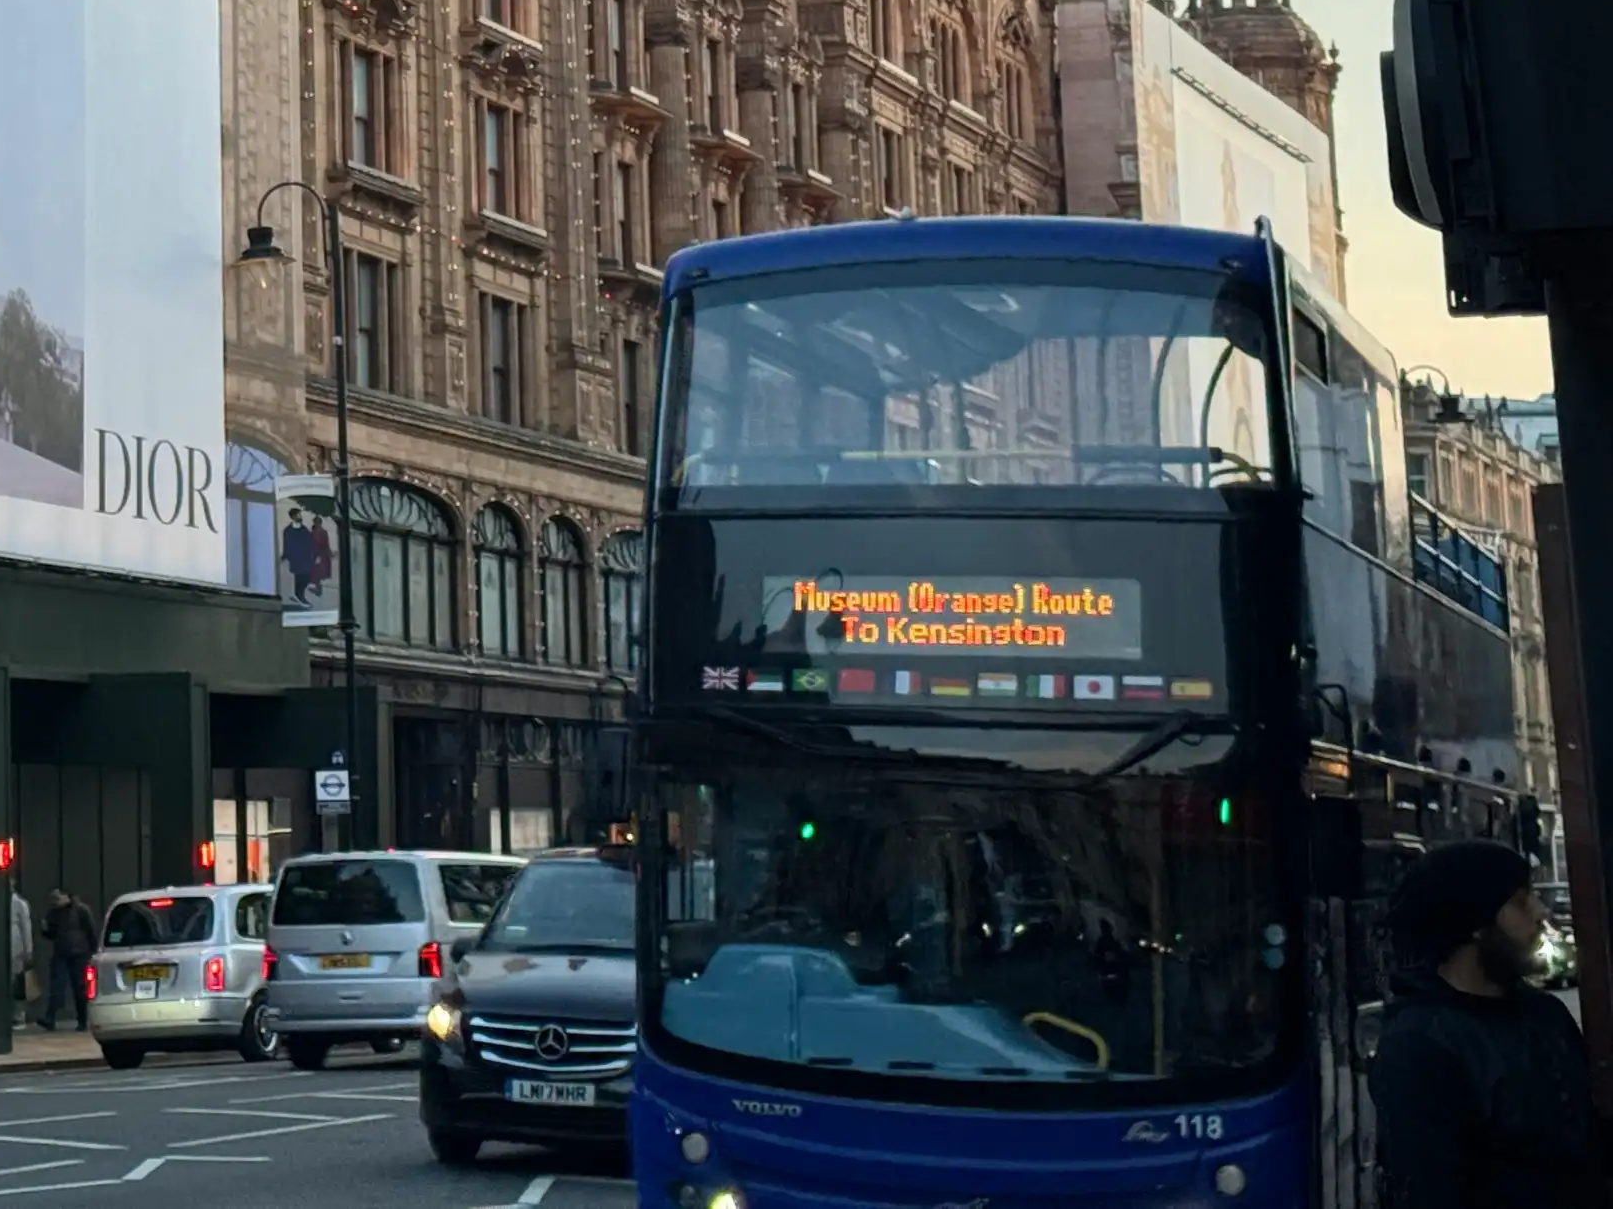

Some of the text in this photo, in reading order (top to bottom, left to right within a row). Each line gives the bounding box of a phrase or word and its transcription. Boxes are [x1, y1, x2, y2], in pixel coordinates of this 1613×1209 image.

[93, 428, 218, 534] DIOR
[794, 579, 901, 614] Museum
[1032, 582, 1114, 615] Route
[840, 616, 1066, 647] To Kensington
[731, 1098, 803, 1118] VOLVO
[1173, 1114, 1224, 1140] 118
